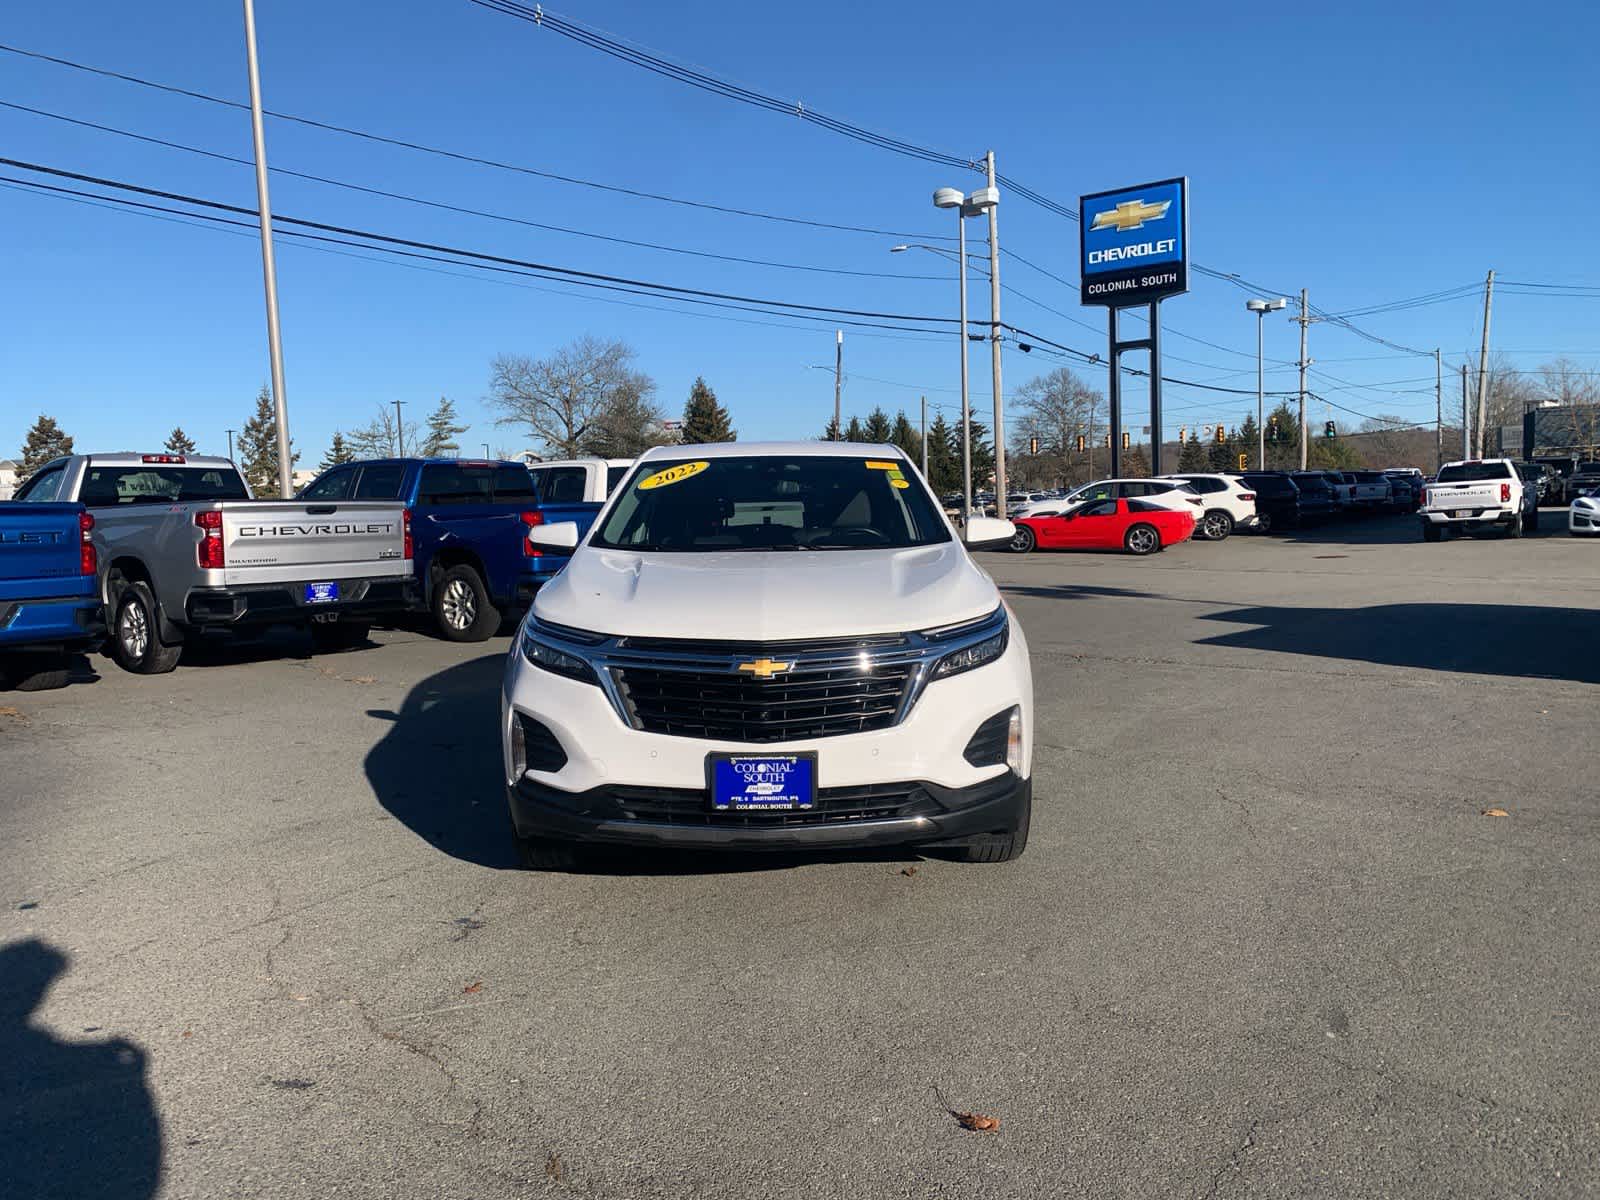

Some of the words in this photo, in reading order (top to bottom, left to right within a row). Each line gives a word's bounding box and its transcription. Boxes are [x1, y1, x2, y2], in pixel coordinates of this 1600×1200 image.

[1088, 239, 1176, 264] CHEVROLET
[1088, 279, 1139, 295] COLONIAL
[1141, 273, 1177, 287] SOUTH
[656, 464, 698, 486] 2022
[239, 524, 393, 537] CHEVROLET
[734, 763, 794, 773] COLONIAL
[743, 773, 785, 782] SOUTH
